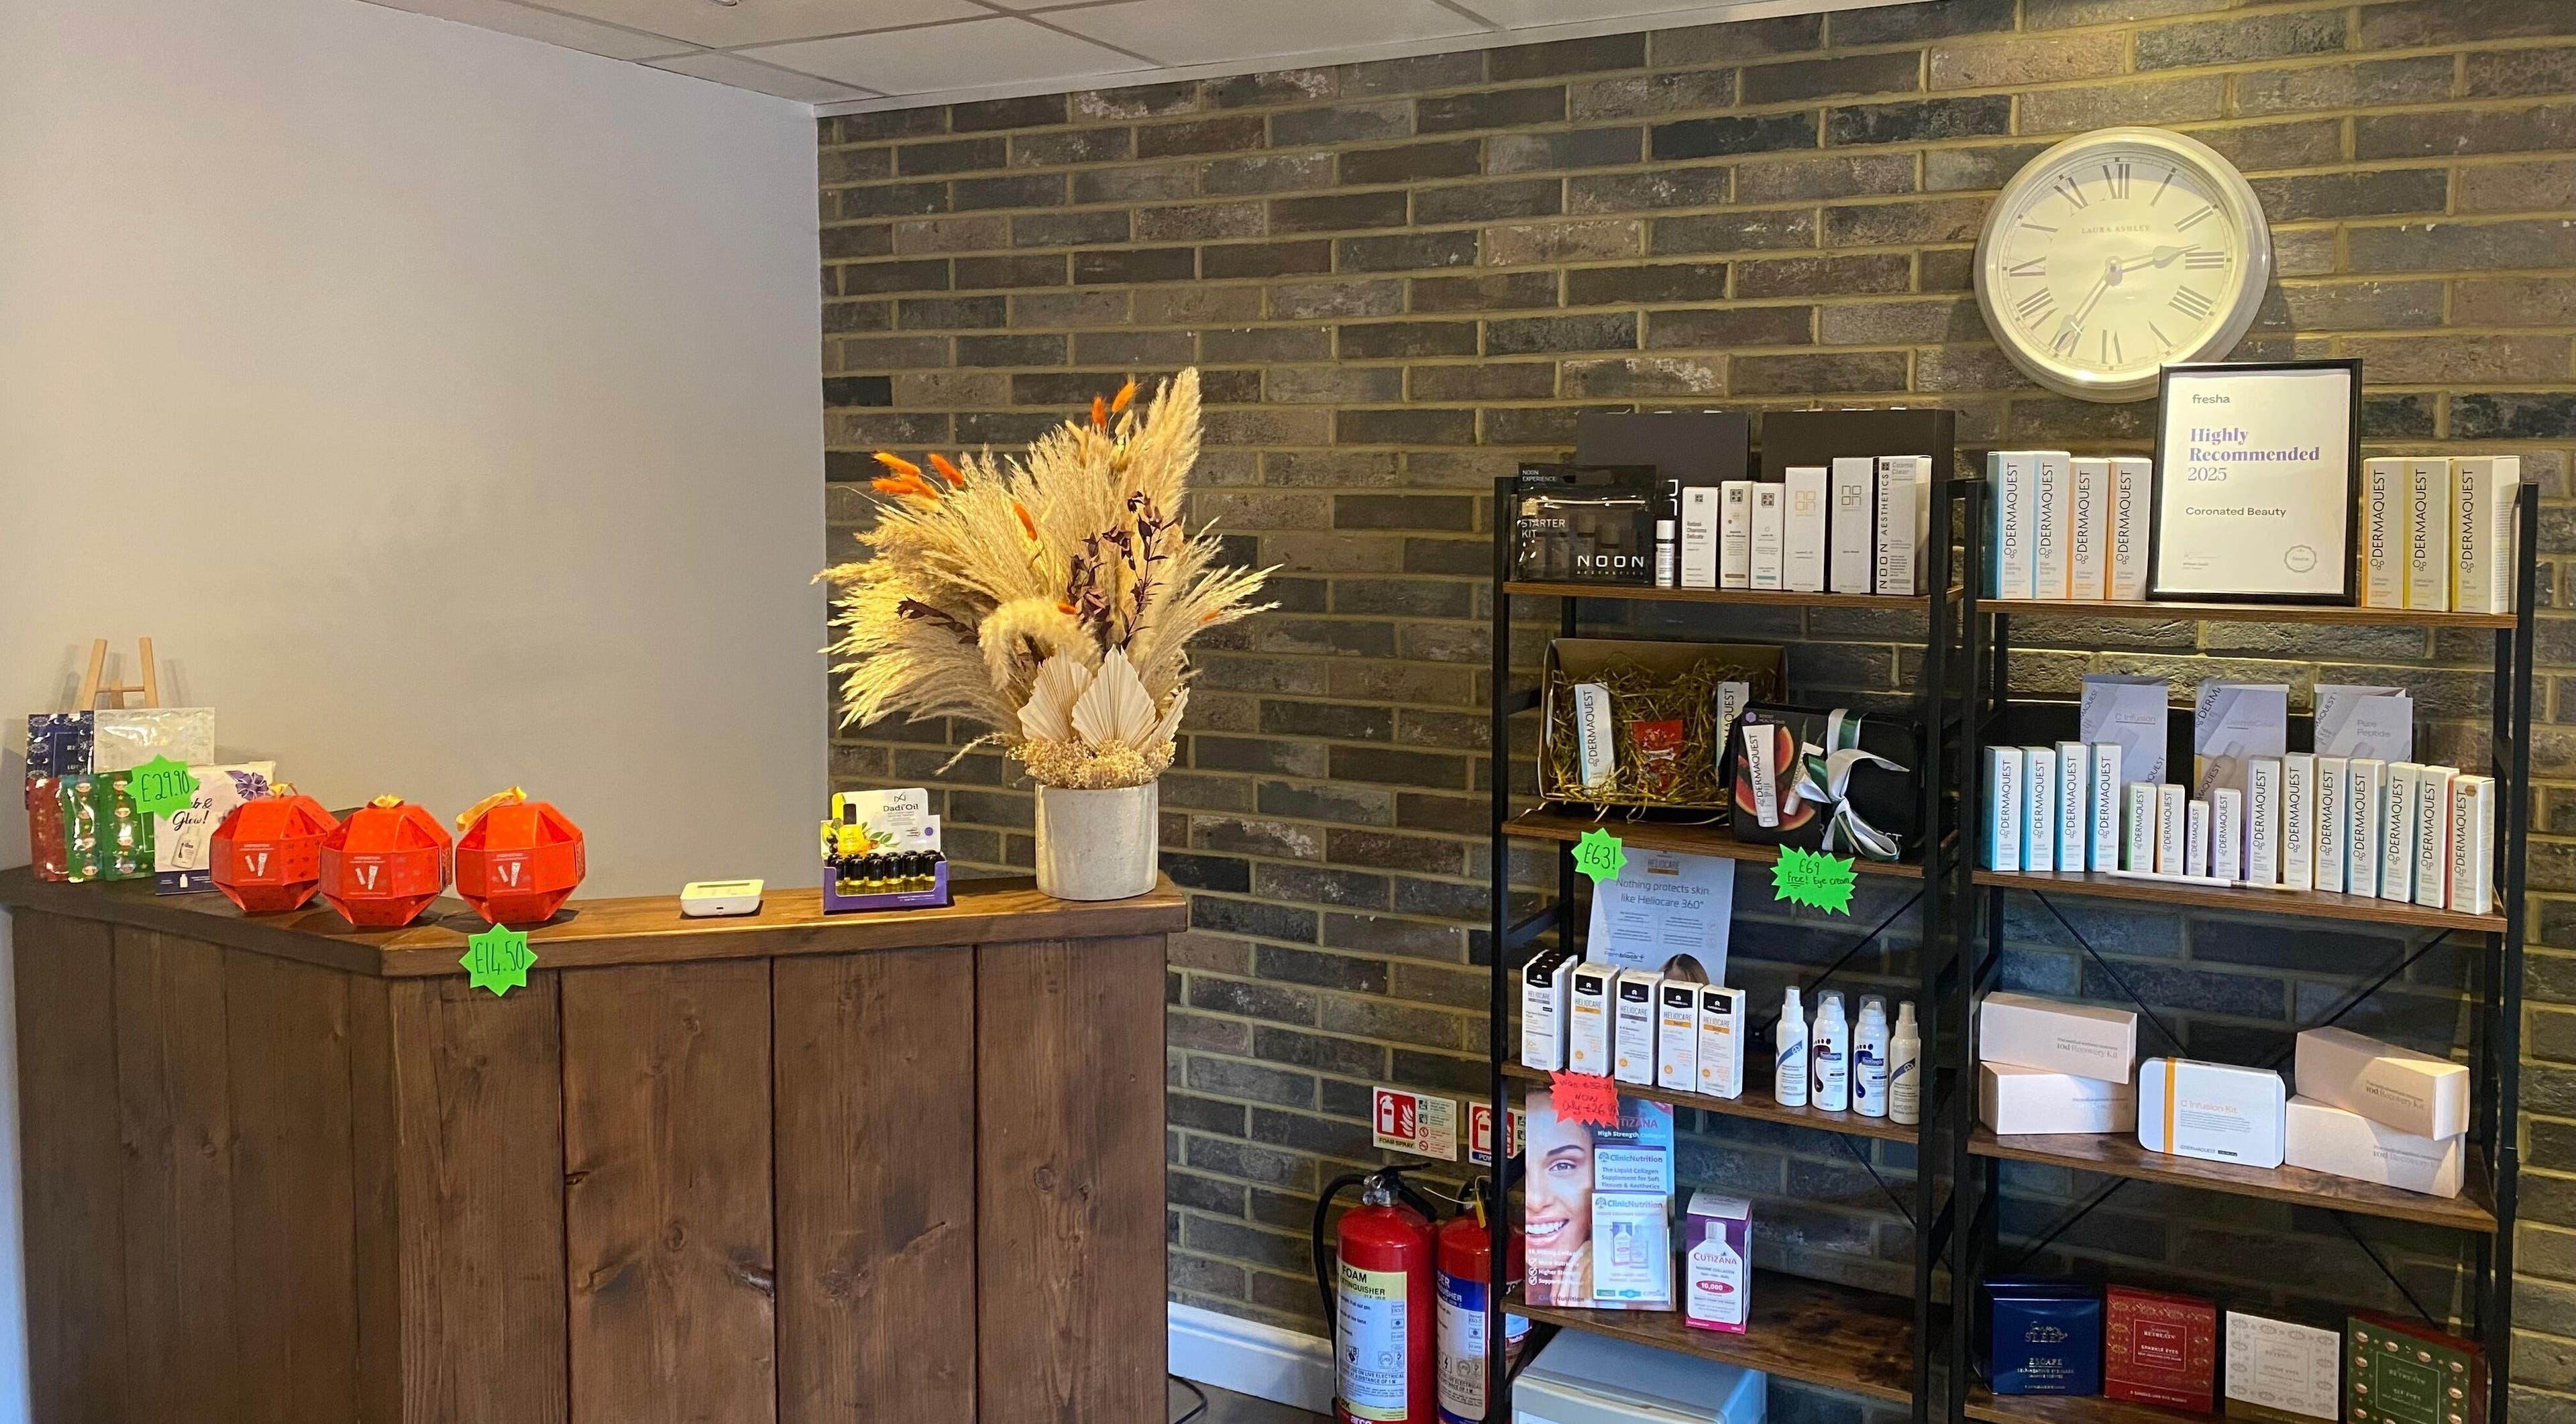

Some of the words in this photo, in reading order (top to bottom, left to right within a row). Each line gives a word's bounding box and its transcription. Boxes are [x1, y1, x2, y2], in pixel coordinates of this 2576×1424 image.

[2082, 227, 2111, 235] LAURA
[2115, 225, 2151, 233] ASHLEY
[2192, 394, 2231, 404] fresha
[2190, 427, 2249, 445] Highly
[2189, 447, 2320, 462] Recommended
[2188, 467, 2227, 482] 2025
[1880, 474, 1889, 536] AESTHETICS
[2006, 463, 2018, 547] DERMAQUEST
[2040, 463, 2053, 547] DERMAQUEST
[2077, 470, 2090, 553] DERMAQUEST
[2118, 470, 2132, 553] DERMAQUEST
[2186, 506, 2245, 516] Coronated
[2248, 507, 2287, 518] Beauty
[2372, 470, 2385, 558] DERMAQUEST
[2415, 469, 2427, 559] DERMAQUEST
[2462, 468, 2474, 560] DERMAQUEST
[1521, 519, 1566, 528] STARTER
[1521, 529, 1537, 537] KIT
[1577, 555, 1644, 567] NOON
[1879, 543, 1888, 589] NOON
[1583, 690, 1598, 758] DERMAQUEST
[2114, 712, 2123, 720] C
[2124, 713, 2157, 722] Infusion
[2357, 720, 2377, 728] Pure
[2357, 728, 2391, 738] Peptide
[1750, 734, 1764, 798] DERMAQUEST
[2000, 759, 2012, 829] DERMAQUEST
[2034, 760, 2046, 830] DERMAQUEST
[2067, 756, 2077, 829] DERMAQUEST
[2100, 757, 2112, 829] DERMAQUEST
[2255, 769, 2266, 840] DERMAQUEST
[2290, 767, 2300, 842] DERMAQUEST
[2321, 769, 2334, 844] DERMAQUEST
[2355, 773, 2366, 851] DERMAQUEST
[172, 810, 209, 832] Glow!
[2135, 789, 2145, 843] DERMAQUEST
[2163, 792, 2174, 845] DERMAQUEST
[2219, 795, 2229, 850] DERMAQUEST
[2391, 776, 2404, 855] DERMAQUEST
[2422, 780, 2436, 859] DERMAQUEST
[2190, 808, 2200, 853] DERMAQUEST
[2456, 790, 2467, 866] DERMAQUEST
[1616, 878, 1652, 891] Nothing
[1653, 882, 1690, 894] protects
[1691, 885, 1710, 895] skin
[1787, 871, 1809, 885] Free!
[1813, 877, 1827, 889] Eye
[1830, 877, 1850, 885] cream
[1621, 893, 1637, 904] like
[1638, 893, 1680, 908] Heliocare
[1527, 991, 1550, 1001] HELIOCARE
[1575, 998, 1603, 1008] HELIOCARE
[1620, 1006, 1648, 1016] HELIOCARE
[1664, 1011, 1693, 1021] HELIOCARE
[1703, 1016, 1731, 1027] HELIOCARE
[2072, 1044, 2105, 1058] Recovery
[2106, 1050, 2118, 1058] Kit
[2189, 1100, 2224, 1112] Infusion
[2225, 1105, 2239, 1113] Kit
[2379, 1090, 2413, 1108] Recovery
[1613, 1131, 1639, 1139] Strength
[1610, 1154, 1663, 1163] ClinicNutrition
[1607, 1199, 1663, 1209] ClinicNutrition
[1694, 1252, 1737, 1266] CUTIZANA
[1342, 1264, 1367, 1283] FOAM
[2141, 1345, 2164, 1353] SPARKLE
[2029, 1358, 2063, 1366] ESCAPE
